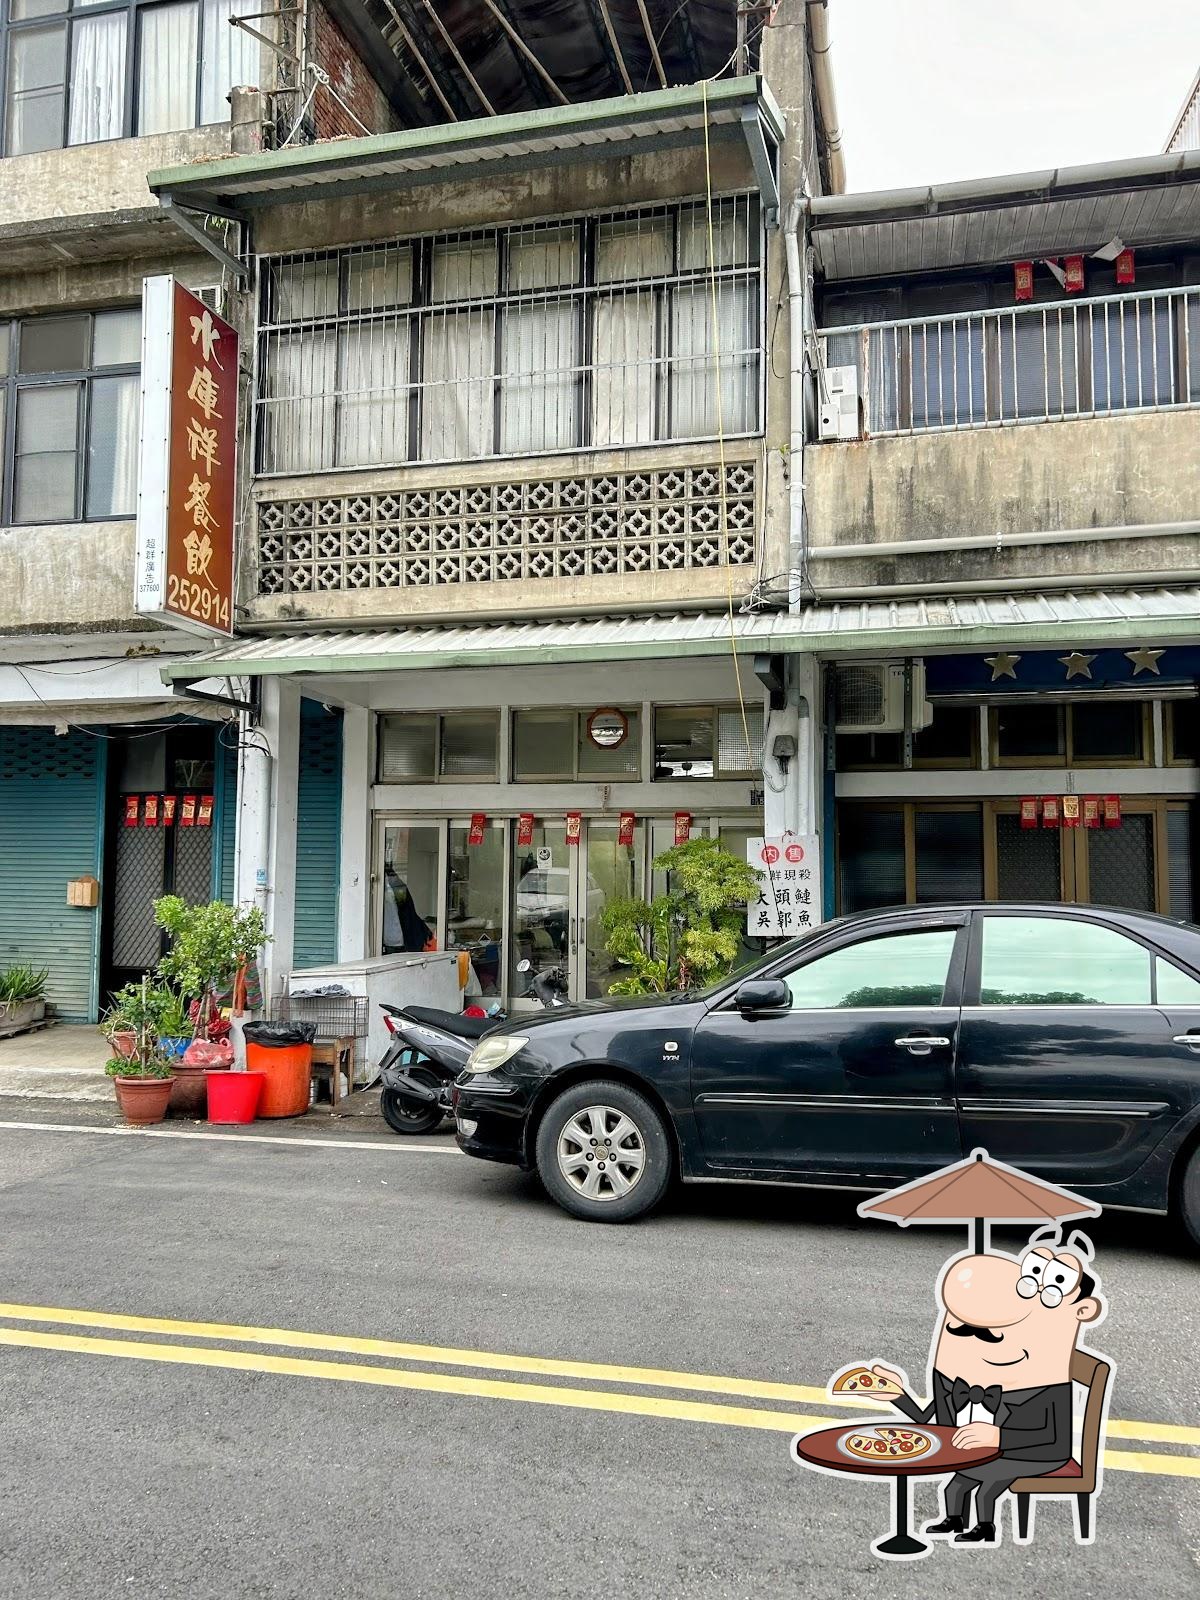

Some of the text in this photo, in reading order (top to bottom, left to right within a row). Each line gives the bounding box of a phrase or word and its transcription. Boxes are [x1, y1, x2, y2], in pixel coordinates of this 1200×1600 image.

[183, 309, 224, 591] 水庫祥餐飲
[168, 574, 230, 628] 252914
[755, 869, 811, 881] 新鮮現殺
[756, 910, 812, 928] 吳郭魚
